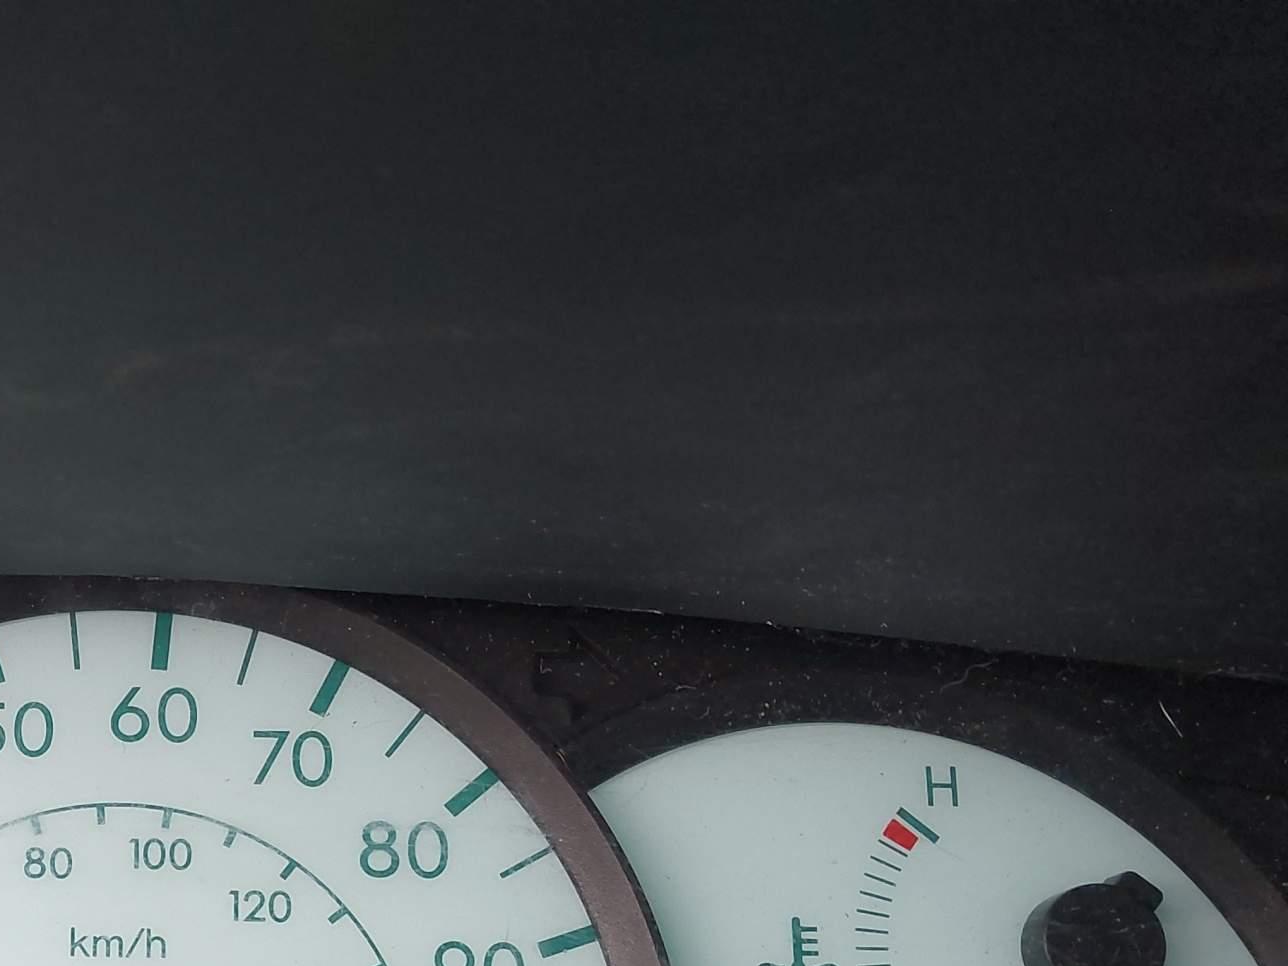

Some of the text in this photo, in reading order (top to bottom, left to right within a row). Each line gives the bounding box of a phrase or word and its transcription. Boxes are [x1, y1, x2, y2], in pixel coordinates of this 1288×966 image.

[110, 686, 199, 744] 60
[252, 730, 333, 788] 70
[925, 766, 959, 807] H
[22, 847, 73, 880] 80
[129, 838, 193, 871] 100
[358, 820, 449, 880] 80
[229, 889, 292, 923] 120
[69, 927, 167, 960] km/h
